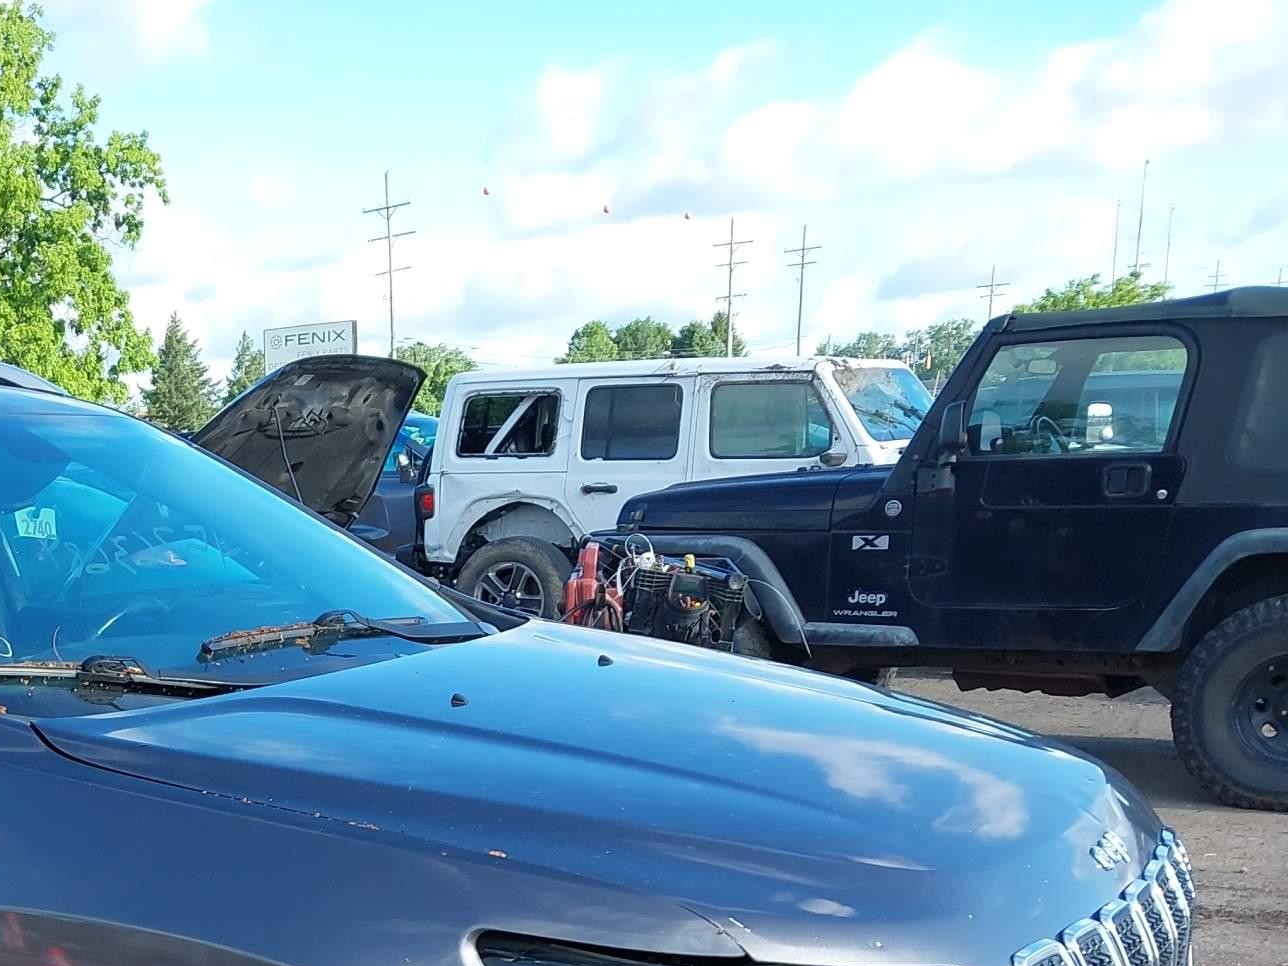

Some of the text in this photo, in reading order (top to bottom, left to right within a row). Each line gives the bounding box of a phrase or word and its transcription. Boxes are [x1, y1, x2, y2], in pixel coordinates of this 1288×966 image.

[284, 328, 346, 347] FENIX
[20, 519, 53, 538] 2740
[847, 590, 887, 607] Jeep
[833, 609, 899, 618] WRANGLER
